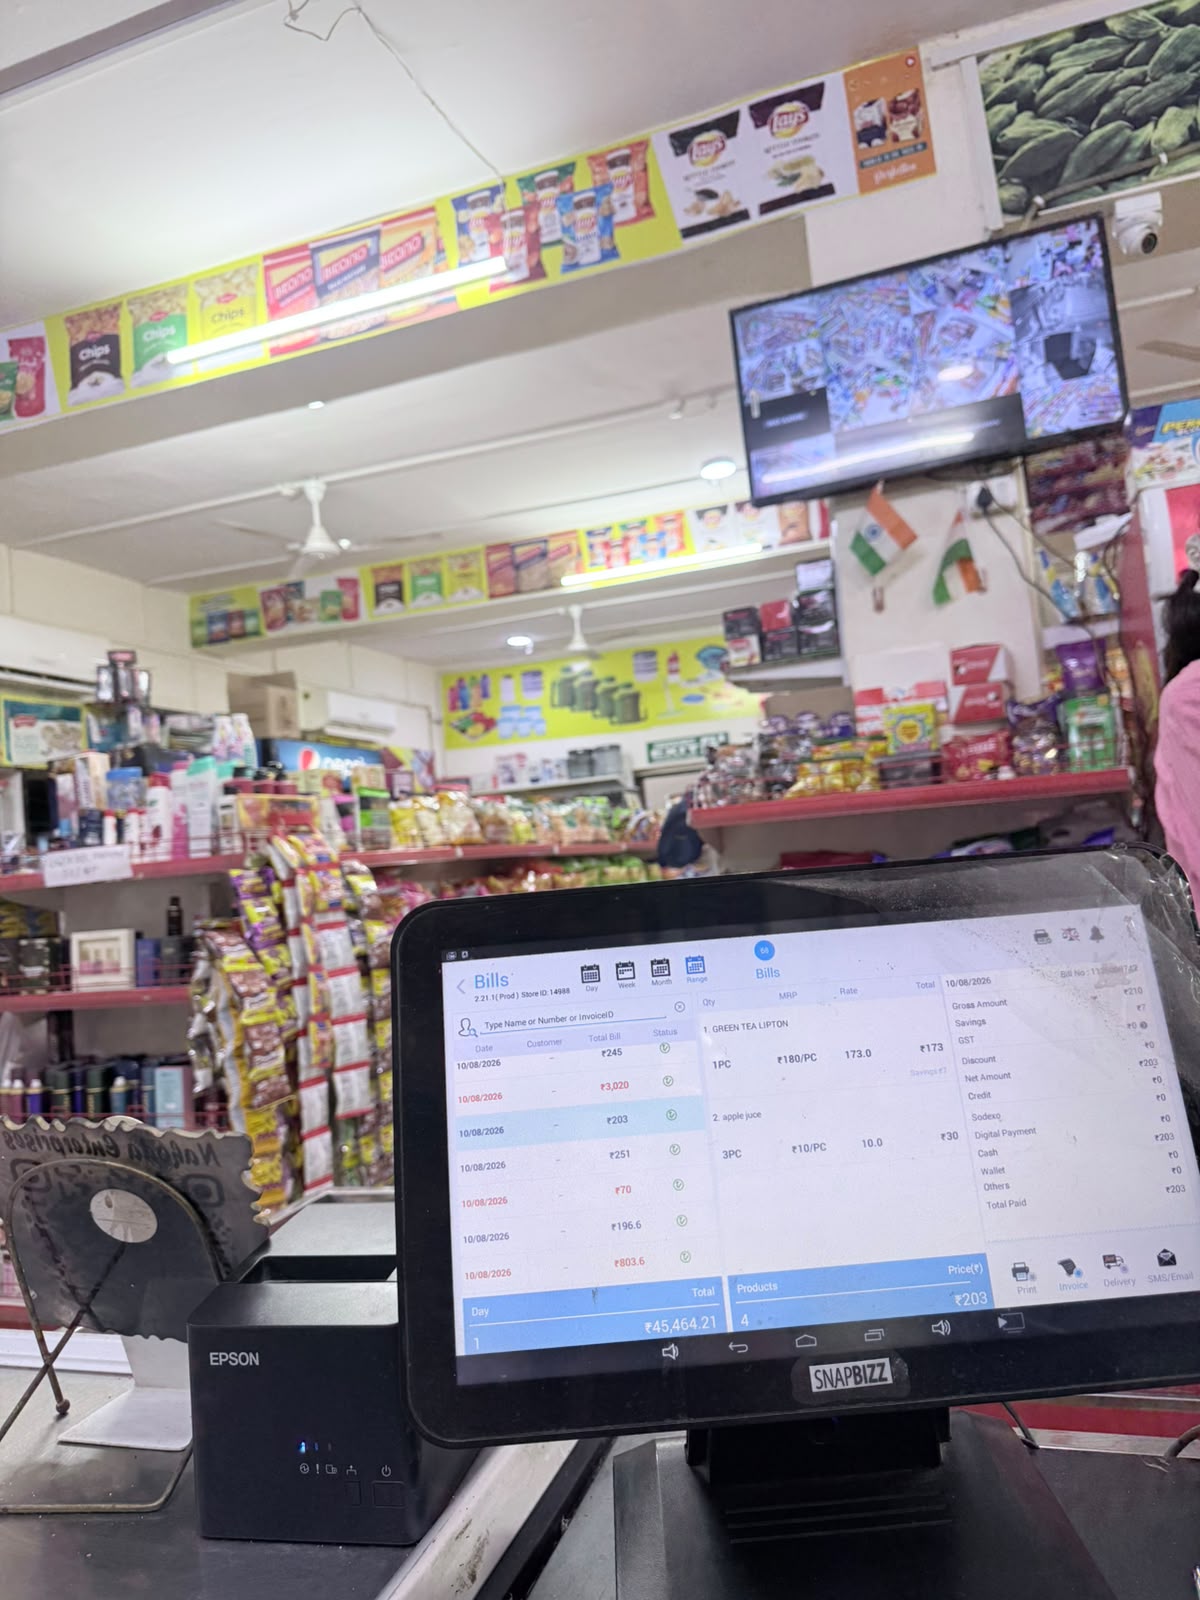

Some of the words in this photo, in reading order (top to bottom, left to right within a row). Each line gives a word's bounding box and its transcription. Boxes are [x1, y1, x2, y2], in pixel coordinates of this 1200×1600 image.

[211, 307, 244, 323] Chips
[143, 324, 176, 342] Chips
[79, 343, 111, 361] Chips
[474, 972, 509, 989] Bills
[618, 980, 636, 989] Week
[651, 977, 672, 986] Month
[686, 975, 708, 985] Range
[755, 967, 781, 979] Bills
[945, 976, 991, 988] 10/08/2026
[521, 990, 539, 999] Store
[549, 987, 571, 996] 14988
[585, 985, 599, 993] Day
[703, 998, 716, 1007] Qty
[779, 991, 798, 1000] MRP
[839, 986, 858, 995] Rate
[916, 980, 935, 990] Total
[952, 1000, 976, 1011] Gross
[977, 998, 1008, 1009] Amount
[1123, 986, 1143, 996] ₹210
[484, 1019, 503, 1030] Type
[504, 1017, 526, 1028] Name
[527, 1018, 536, 1026] or
[537, 1015, 568, 1026] Number
[569, 1014, 578, 1023] or
[579, 1010, 614, 1022] InvoiceID
[712, 1023, 740, 1034] GREEN
[741, 1021, 758, 1031] TEA
[758, 1019, 789, 1030] LIPTON
[955, 1017, 987, 1029] Savings
[1136, 1003, 1146, 1013] ₹7
[475, 1043, 494, 1053] Date
[526, 1037, 563, 1048] Customer
[588, 1033, 606, 1043] Total
[607, 1032, 621, 1042] Bill
[653, 1027, 678, 1038] Status
[958, 1035, 975, 1045] GST
[1127, 1021, 1138, 1031] ₹0
[456, 1058, 502, 1071] 10/08/2026
[601, 1047, 623, 1059] ₹245
[712, 1059, 732, 1070] 1PC
[777, 1052, 818, 1065] ₹180/PC
[845, 1048, 872, 1060] 173.0
[920, 1042, 944, 1054] ₹173
[961, 1054, 997, 1066] Discount
[1144, 1040, 1155, 1050] ₹0
[965, 1073, 979, 1083] Net
[980, 1071, 1011, 1082] Amount
[1139, 1058, 1159, 1068] ₹203
[457, 1091, 503, 1104] 10/08/2026
[600, 1080, 629, 1092] ₹3,020
[968, 1090, 991, 1101] Credit
[1152, 1075, 1163, 1085] ₹0
[722, 1112, 744, 1123] apple
[744, 1110, 762, 1121] juce
[971, 1111, 1001, 1122] Sodexo
[1156, 1093, 1167, 1103] ₹0
[459, 1125, 505, 1139] 10/08/2026
[606, 1114, 629, 1126] ₹203
[974, 1129, 1001, 1141] Digital
[1002, 1126, 1037, 1139] Payment
[1160, 1114, 1171, 1124] ₹0
[722, 1149, 742, 1160] 3PC
[792, 1142, 827, 1154] ₹10/PC
[862, 1137, 884, 1149] 10.0
[940, 1131, 959, 1142] ₹30
[978, 1148, 999, 1158] Cash
[1154, 1132, 1175, 1142] ₹203
[460, 1160, 506, 1173] 10/08/2026
[609, 1149, 631, 1160] ₹251
[981, 1165, 1006, 1176] Wallet
[1168, 1150, 1179, 1160] ₹0
[983, 1181, 1010, 1192] Others
[1171, 1166, 1182, 1176] ₹0
[462, 1195, 508, 1209] 10/08/2026
[615, 1184, 632, 1196] ₹70
[987, 1199, 1007, 1210] Total
[1008, 1198, 1027, 1208] Paid
[1165, 1183, 1186, 1194] ₹203
[463, 1231, 510, 1245] 10/08/2026
[611, 1220, 642, 1232] ₹196.6
[464, 1267, 512, 1281] 10/08/2026
[614, 1256, 645, 1268] ₹803.6
[737, 1281, 778, 1294] Products
[948, 1264, 984, 1277] Price(₹)
[1147, 1272, 1194, 1284] SMS/Email
[1017, 1284, 1037, 1295] Print
[1059, 1280, 1089, 1292] Invoice
[1103, 1277, 1136, 1288] Delivery
[471, 1305, 490, 1319] Day
[691, 1286, 715, 1298] Total
[740, 1313, 749, 1327] 4
[954, 1291, 988, 1307] ₹203
[644, 1315, 717, 1335] ₹45,464.21
[209, 1351, 260, 1367] EPSON
[813, 1362, 889, 1389] SNAPBIZZ
